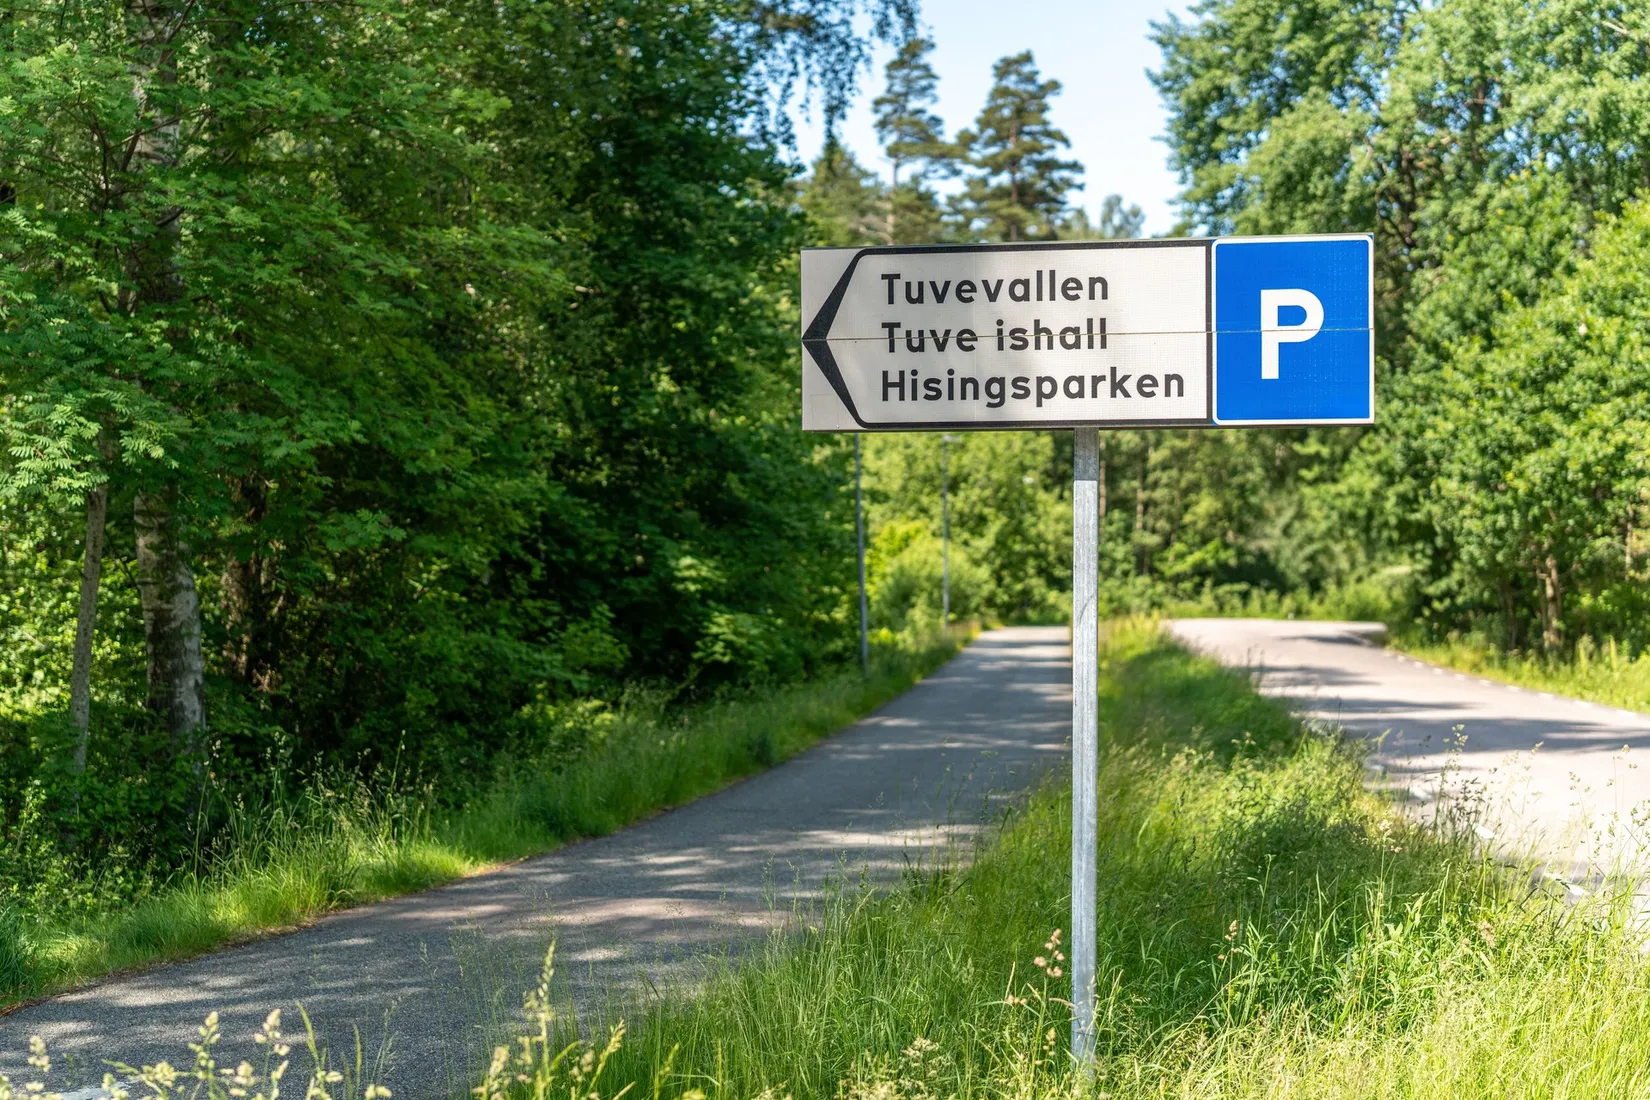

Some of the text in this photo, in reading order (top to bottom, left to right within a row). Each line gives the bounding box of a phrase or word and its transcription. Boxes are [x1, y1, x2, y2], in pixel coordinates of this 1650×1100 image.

[880, 269, 1108, 305] Tuvevallen
[881, 317, 1107, 354] Tuve ishall
[1260, 288, 1325, 380] P
[882, 366, 1184, 409] Hisingsparken
